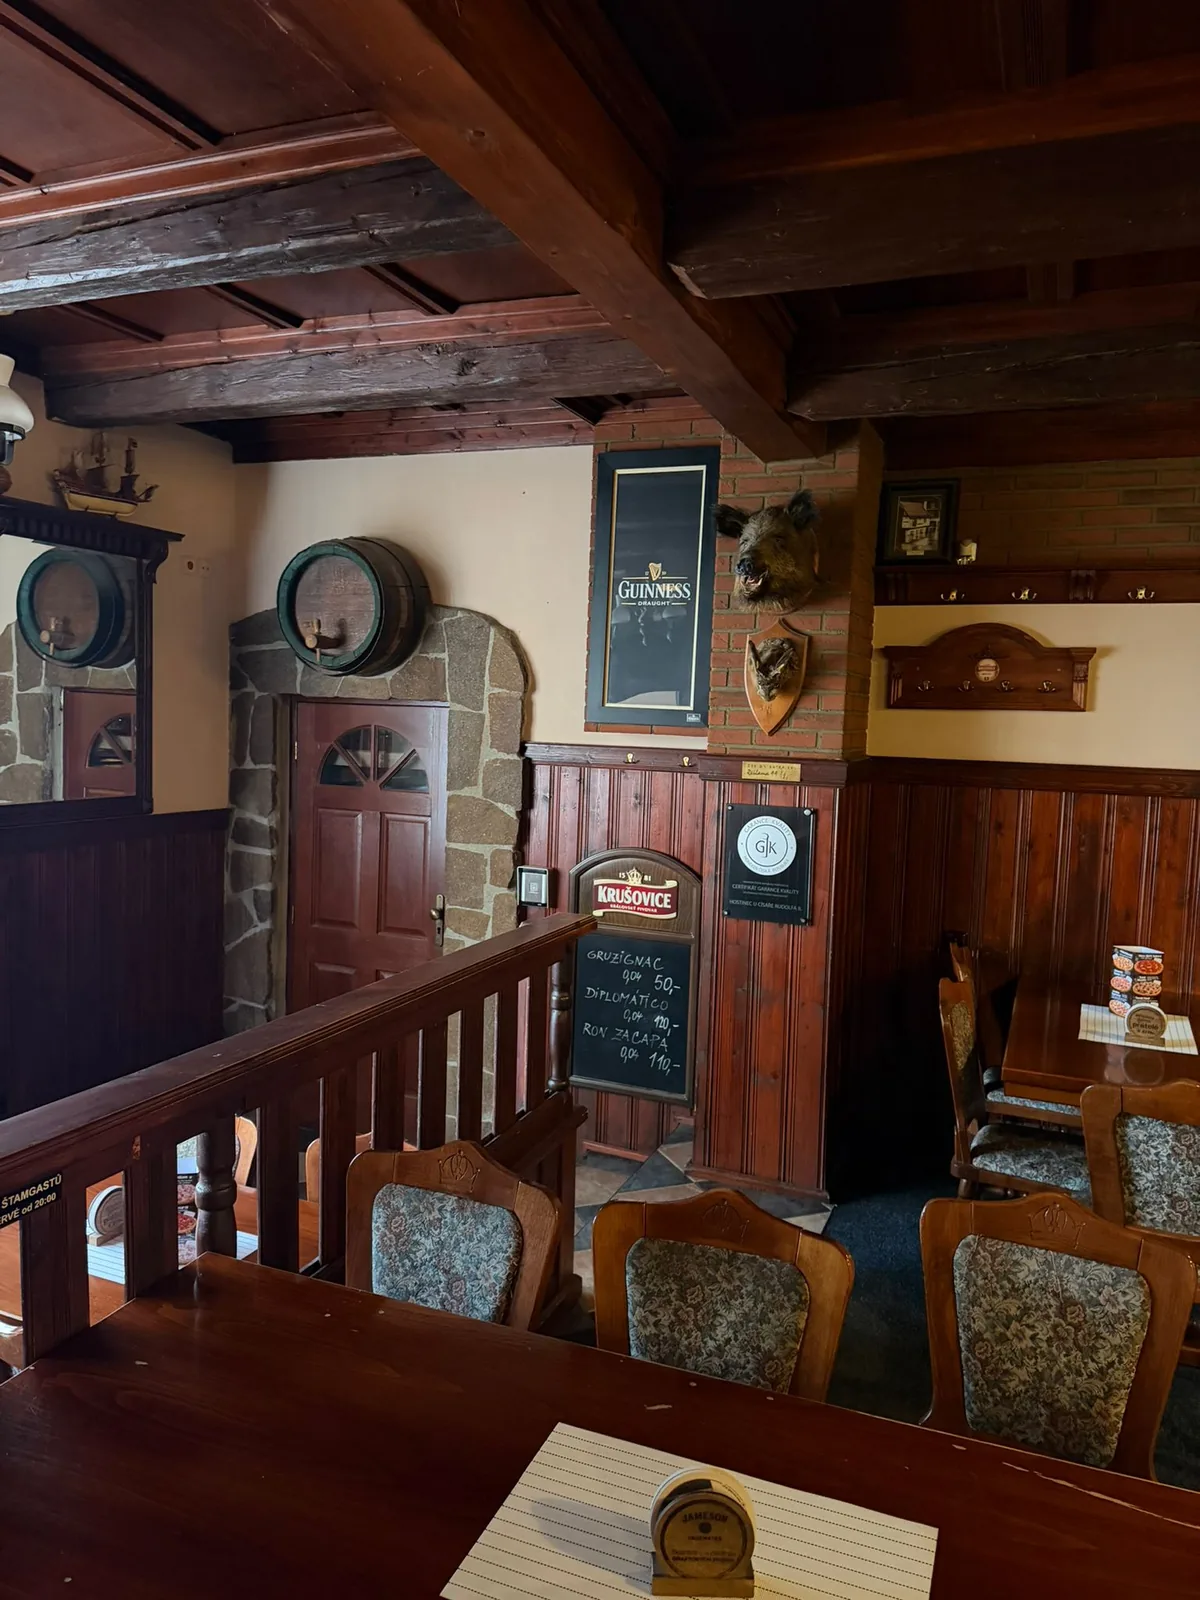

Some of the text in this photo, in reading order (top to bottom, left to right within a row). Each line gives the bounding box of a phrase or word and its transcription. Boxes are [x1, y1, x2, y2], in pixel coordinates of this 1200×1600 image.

[618, 580, 691, 600] GUINNESS
[597, 885, 672, 909] KRUŠOVICE
[582, 1022, 608, 1038] RON
[1, 1173, 62, 1209] ŠTAMGASTŮ
[21, 1202, 33, 1215] od
[34, 1192, 57, 1209] 20:00
[682, 1510, 729, 1523] JAMESON
